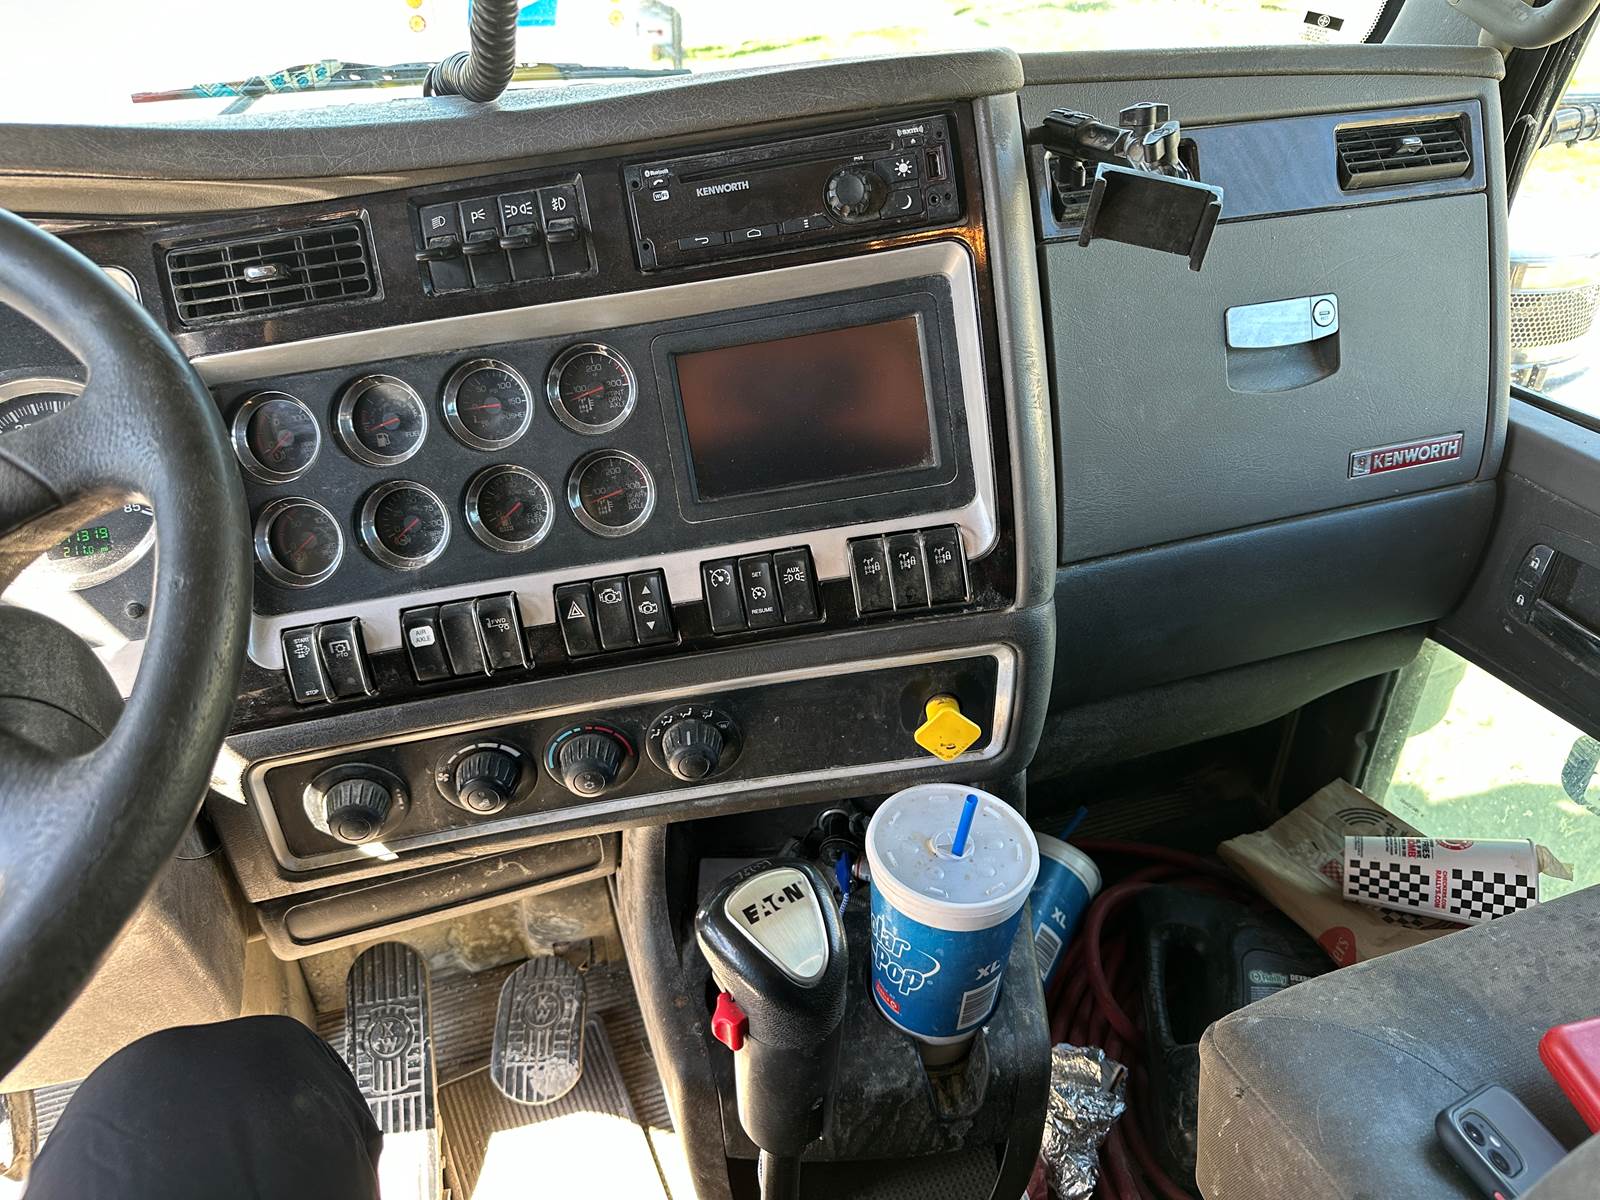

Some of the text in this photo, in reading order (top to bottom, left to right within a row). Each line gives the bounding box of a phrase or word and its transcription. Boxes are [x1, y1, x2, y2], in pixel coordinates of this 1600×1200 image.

[696, 180, 750, 198] KENWORTH
[586, 363, 602, 373] 200
[497, 381, 512, 390] 100
[606, 379, 622, 387] 300
[1372, 439, 1460, 470] KENWORTH
[123, 504, 141, 513] 85
[786, 566, 801, 574] AUX
[751, 606, 774, 615] RESUME
[416, 635, 431, 644] AXLE
[336, 651, 349, 659] PTO
[305, 688, 320, 696] STOP
[741, 882, 805, 925] EATON
[1051, 906, 1067, 930] XL
[975, 960, 1001, 981] XL
